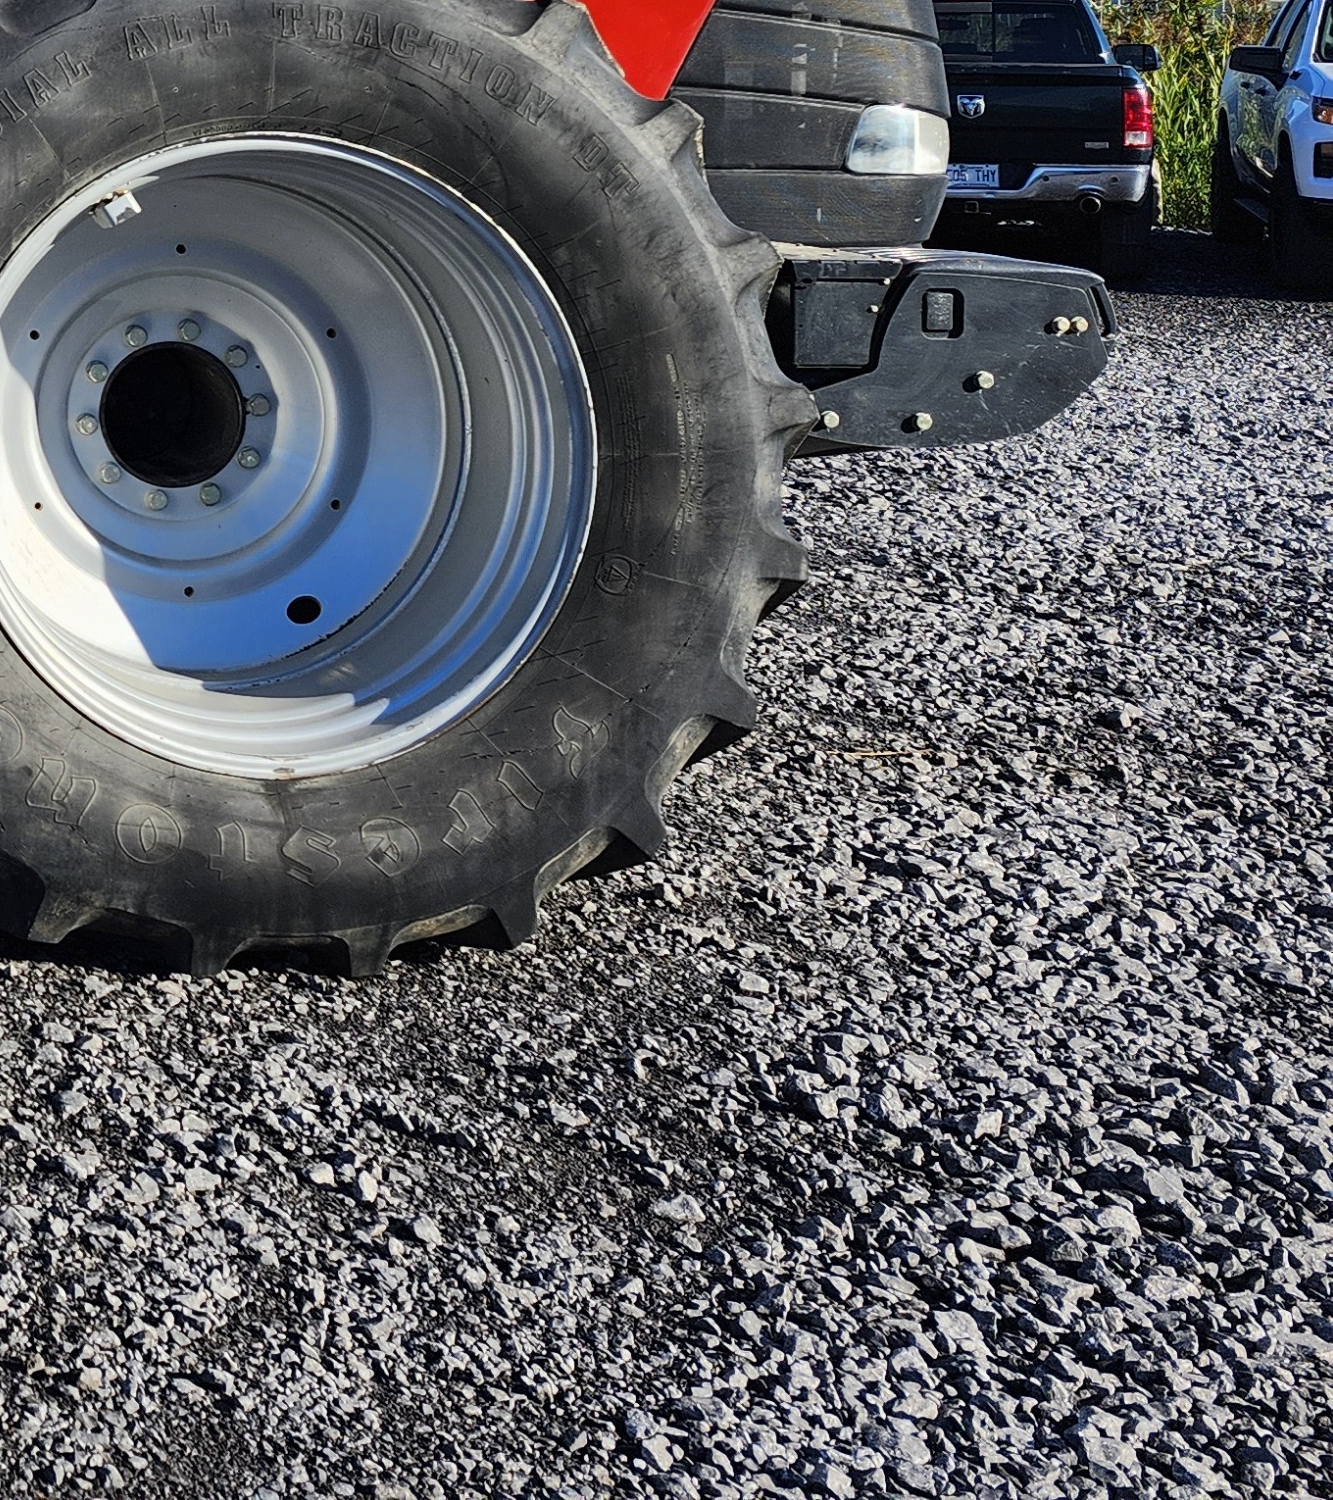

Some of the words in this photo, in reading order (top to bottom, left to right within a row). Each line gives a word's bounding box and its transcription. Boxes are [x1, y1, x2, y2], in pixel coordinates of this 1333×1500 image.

[121, 5, 230, 60] ALL
[273, 2, 555, 127] TRACTION
[572, 140, 640, 201] DT
[975, 169, 997, 182] THY
